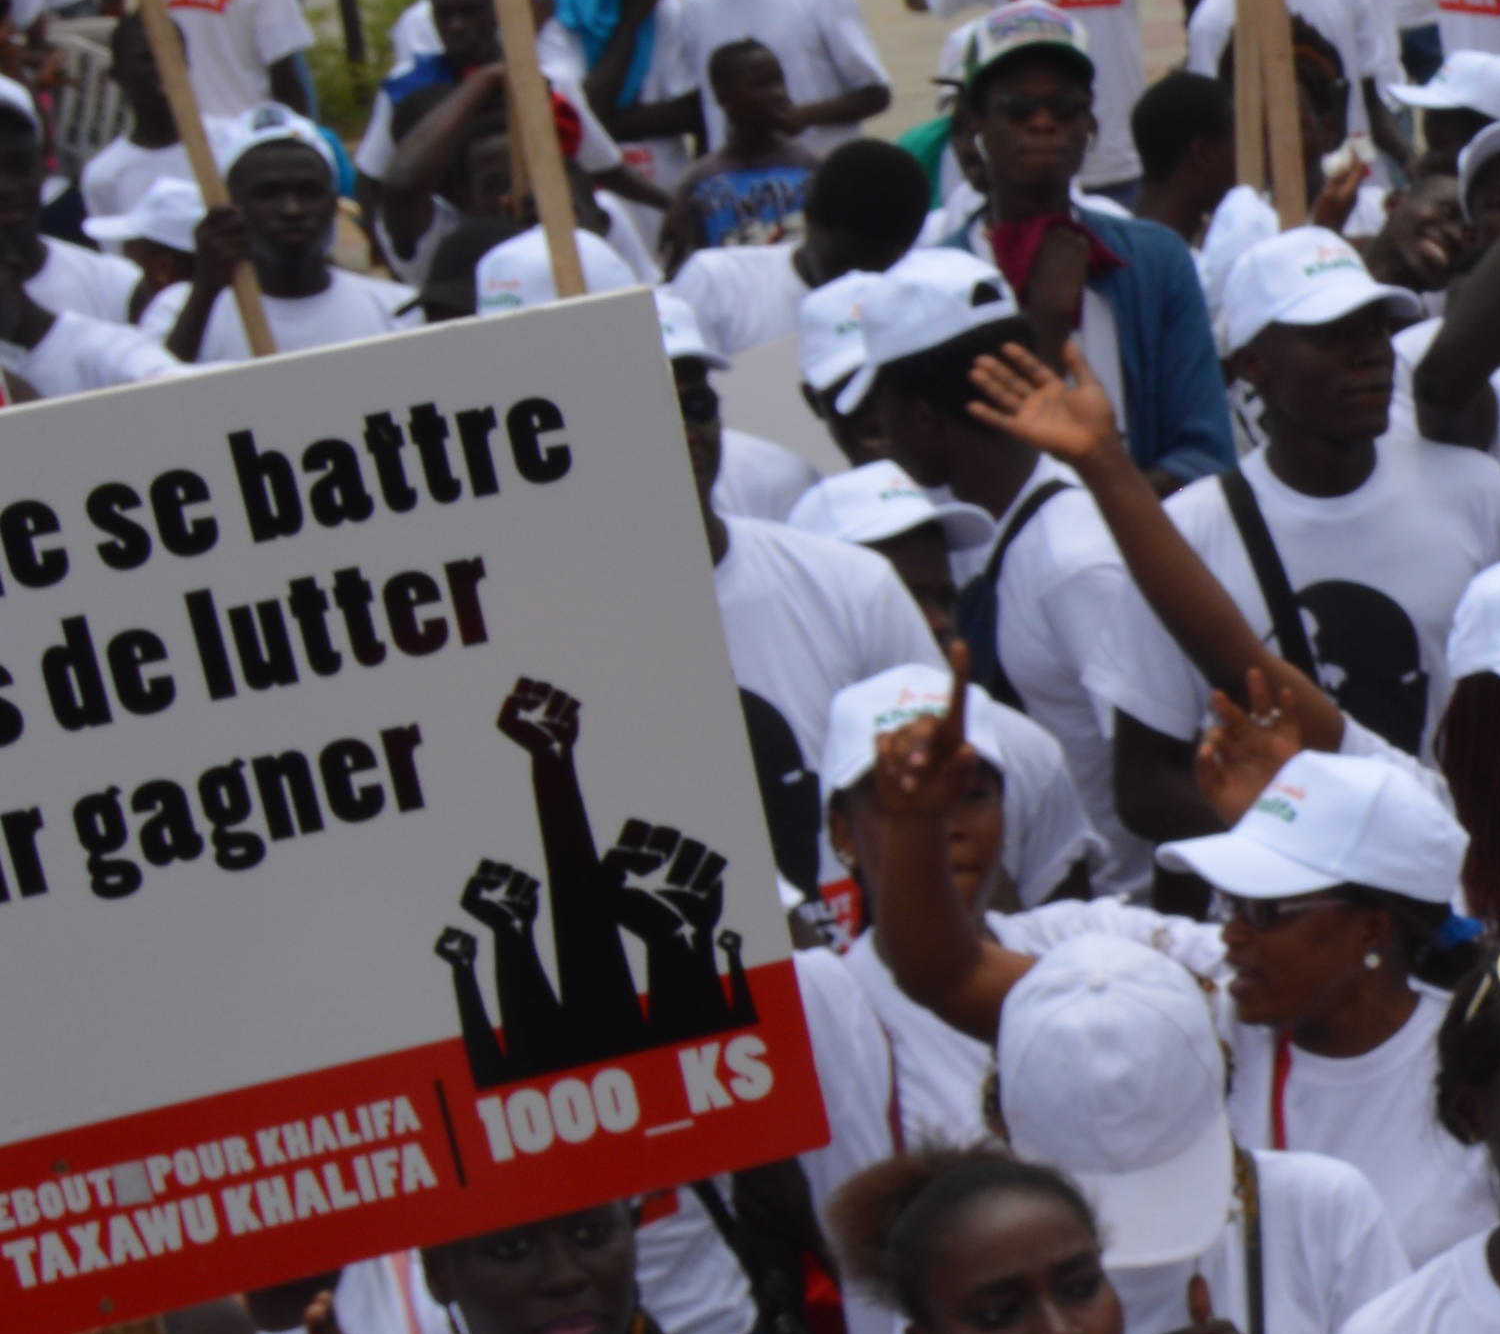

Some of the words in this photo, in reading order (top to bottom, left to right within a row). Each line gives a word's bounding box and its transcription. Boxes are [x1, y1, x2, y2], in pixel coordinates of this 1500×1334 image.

[0, 495, 70, 598] e
[84, 465, 220, 573] se
[226, 393, 575, 545] battre
[40, 612, 177, 736] de
[184, 555, 491, 704] lutter
[70, 721, 428, 903] gagner
[0, 1177, 117, 1235] EBOUT
[149, 1133, 256, 1199] POUR
[255, 1094, 422, 1165] KHALIFA
[474, 1032, 778, 1166] 1000_KS
[2, 1195, 221, 1289] TAXAWU
[223, 1142, 438, 1222] KHALIFA
